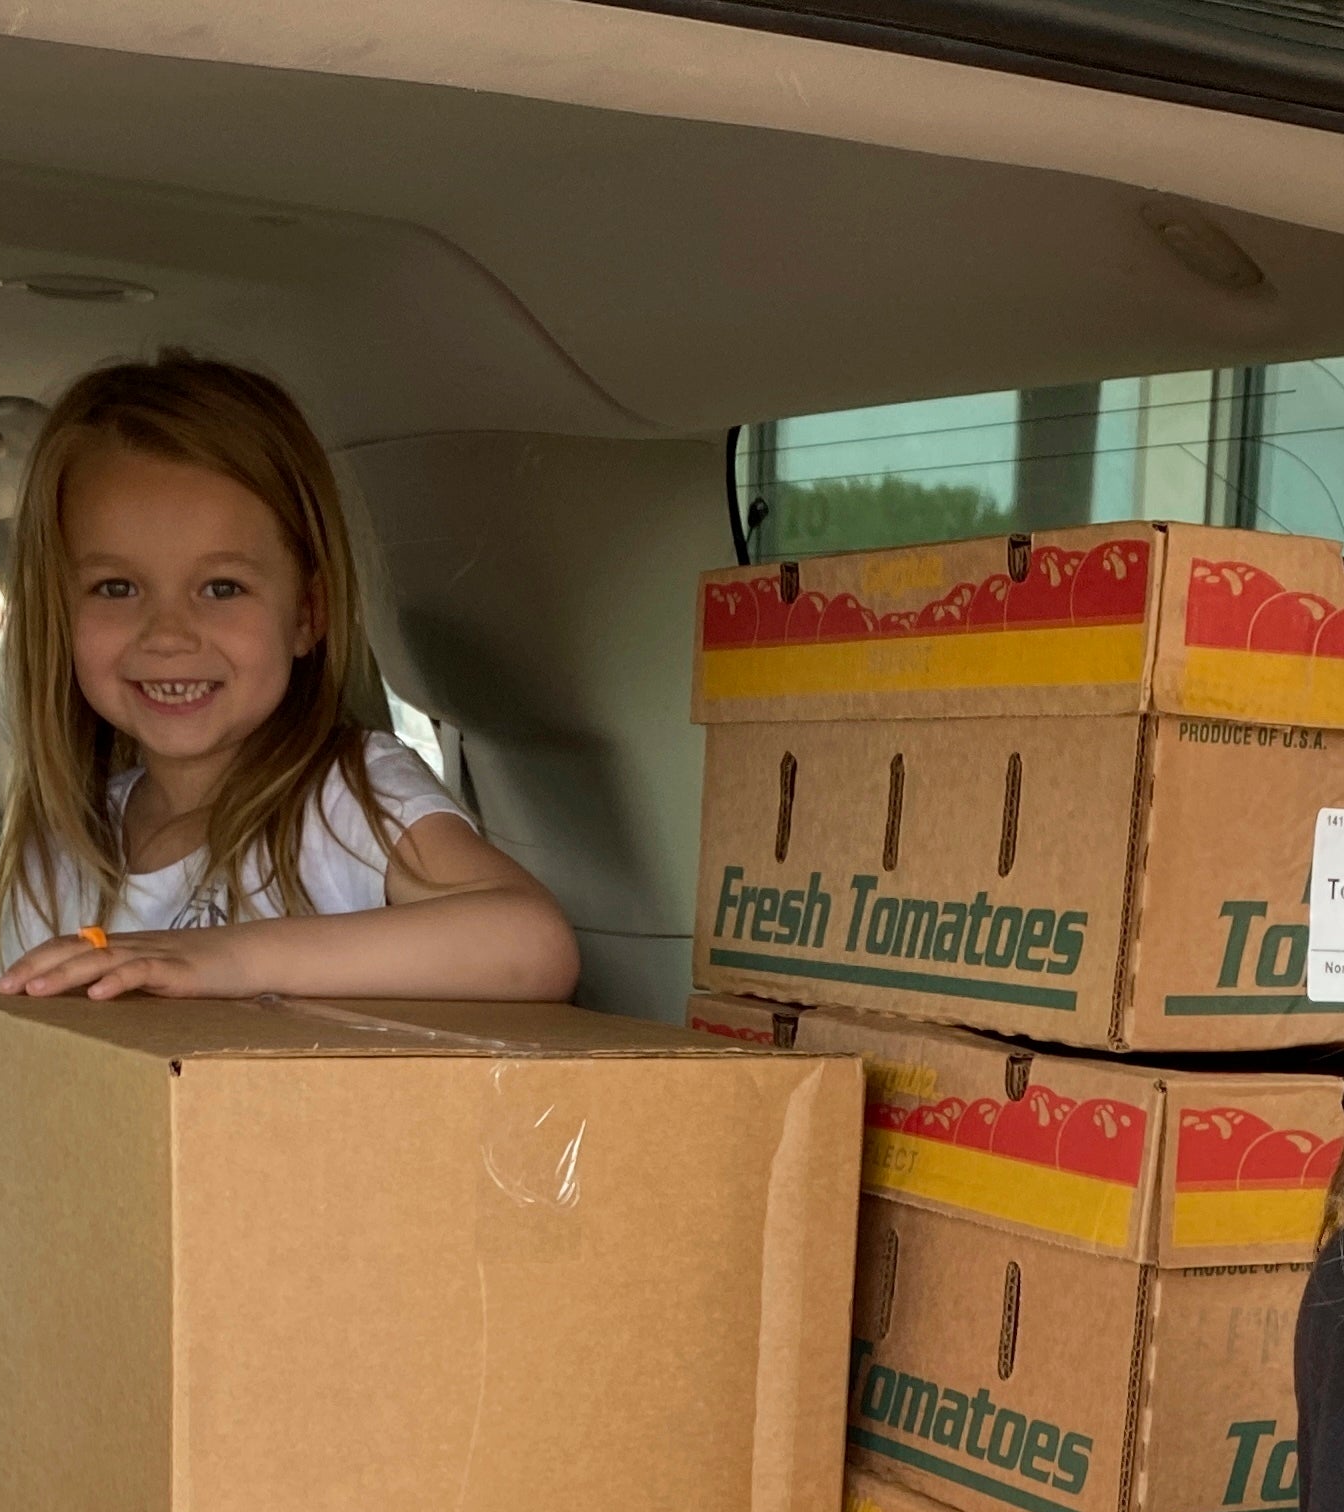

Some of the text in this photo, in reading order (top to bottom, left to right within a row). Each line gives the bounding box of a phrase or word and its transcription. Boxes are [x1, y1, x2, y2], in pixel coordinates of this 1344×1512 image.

[1179, 722, 1252, 744] PRODUCE
[1257, 727, 1278, 747] OF
[1327, 815, 1344, 827] 141
[713, 865, 1089, 976] Fresh Tomatoes
